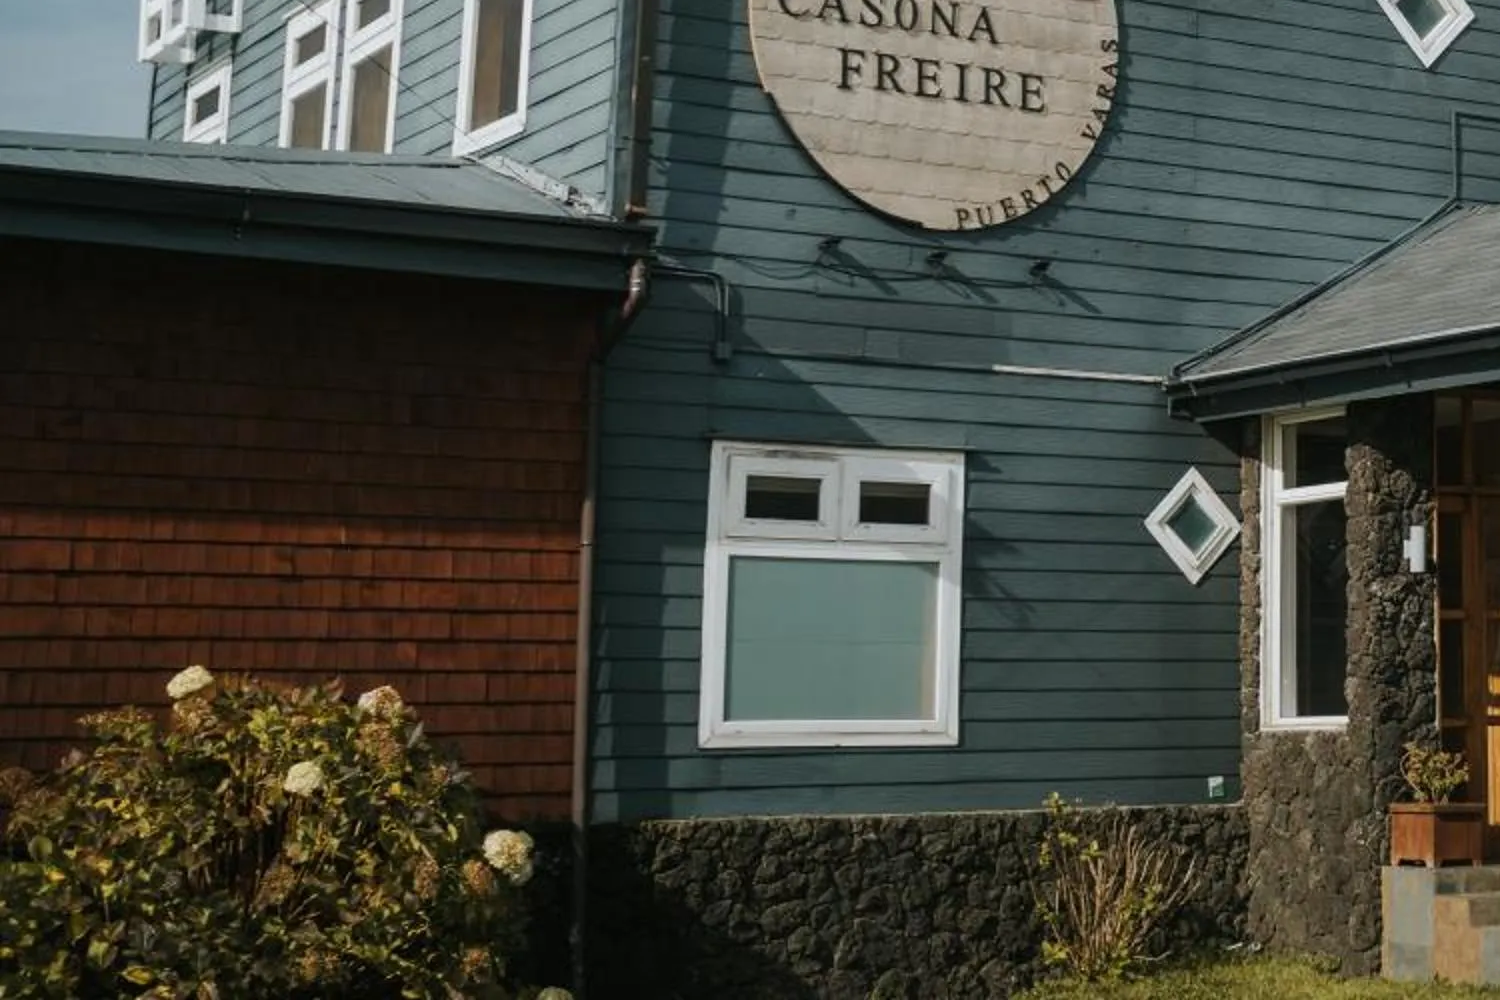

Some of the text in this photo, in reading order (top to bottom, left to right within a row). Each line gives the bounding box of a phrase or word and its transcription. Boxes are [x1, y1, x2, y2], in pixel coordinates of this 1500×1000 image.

[837, 49, 1047, 113] FREIRE
[956, 40, 1118, 229] PUERTO VARAS
